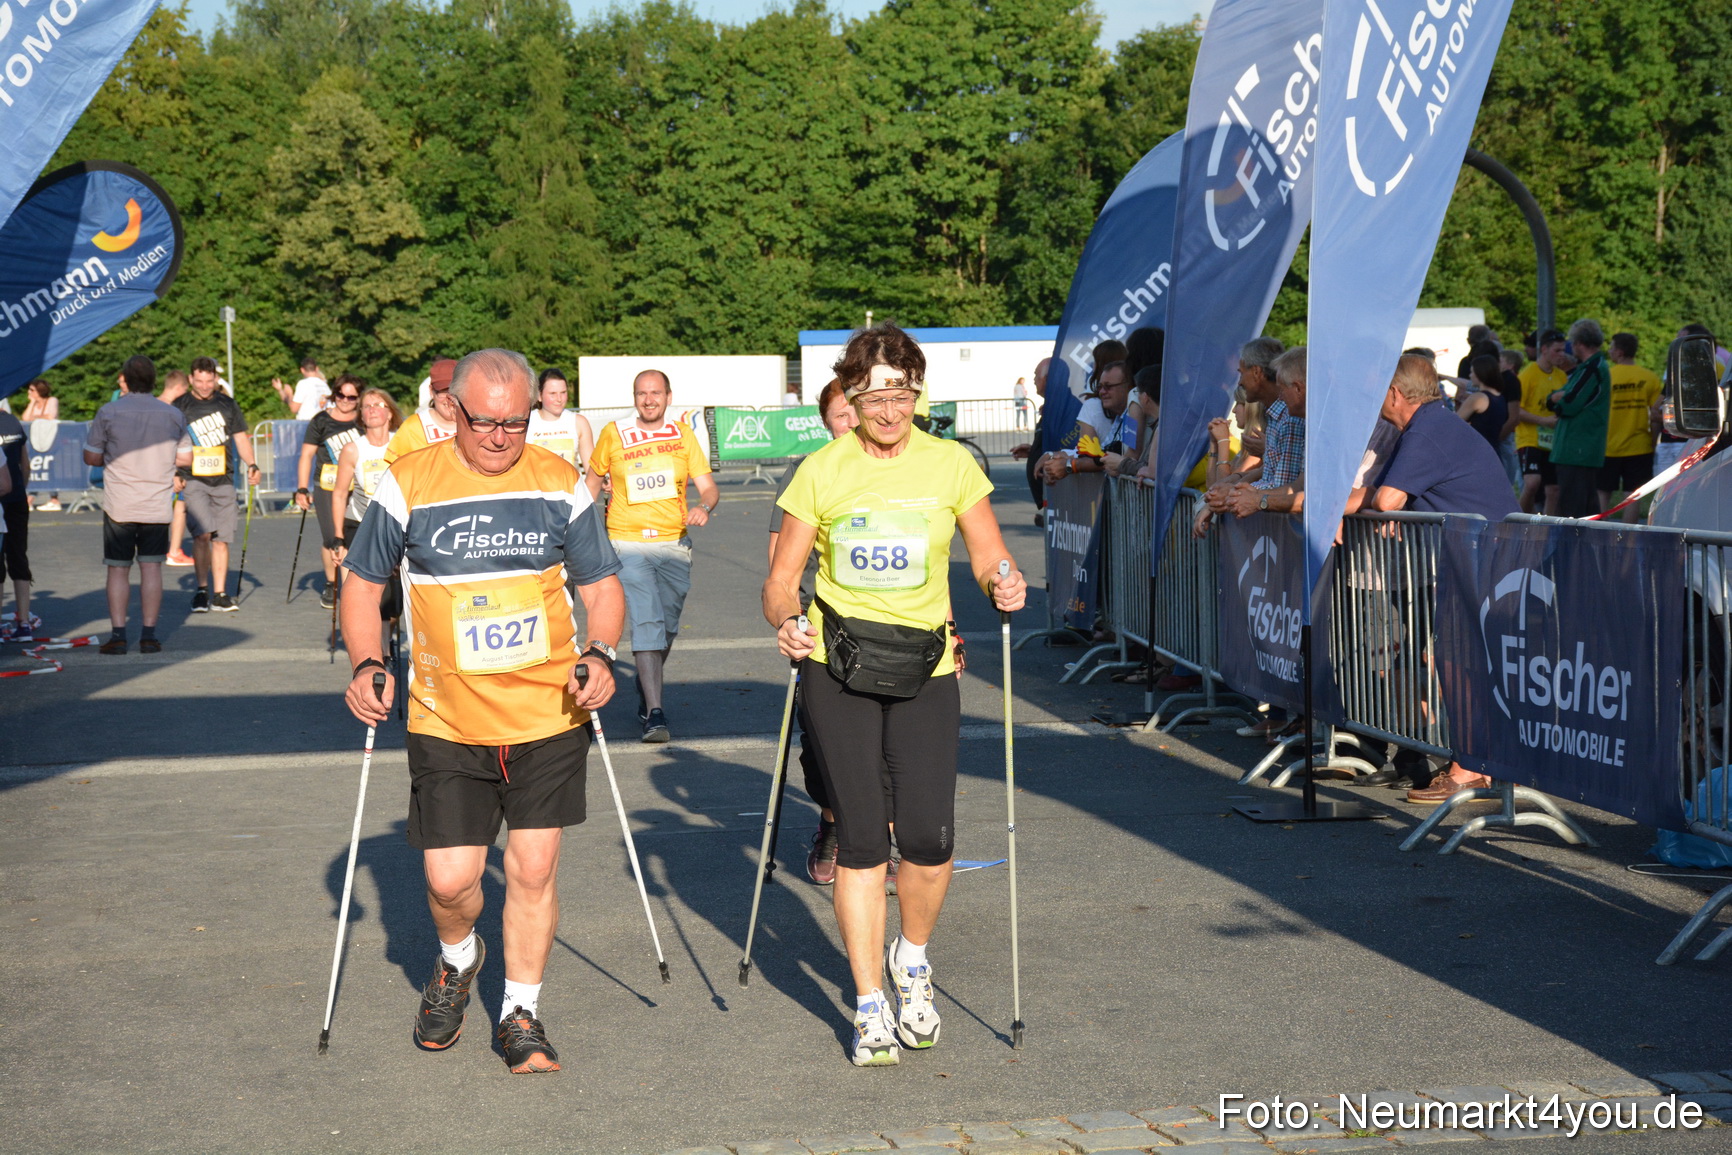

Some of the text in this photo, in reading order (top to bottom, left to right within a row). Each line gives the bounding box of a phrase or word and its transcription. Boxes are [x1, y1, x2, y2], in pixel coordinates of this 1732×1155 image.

[0, 0, 88, 107] TOMO
[1278, 104, 1318, 206] AUTO
[49, 293, 90, 326] Druck
[118, 244, 168, 286] Medien
[725, 415, 772, 442] AOK
[200, 458, 220, 468] 980
[623, 447, 653, 461] MAX
[636, 474, 666, 491] 909
[453, 527, 548, 550] Fischer
[463, 547, 545, 560] AUTOMOBILE
[850, 545, 909, 572] 658
[859, 575, 900, 583] Eleonora Beer
[465, 615, 538, 652] 1627
[481, 655, 504, 664] August
[1501, 634, 1631, 721] Fischer
[1518, 718, 1626, 768] AUTOMOBILE
